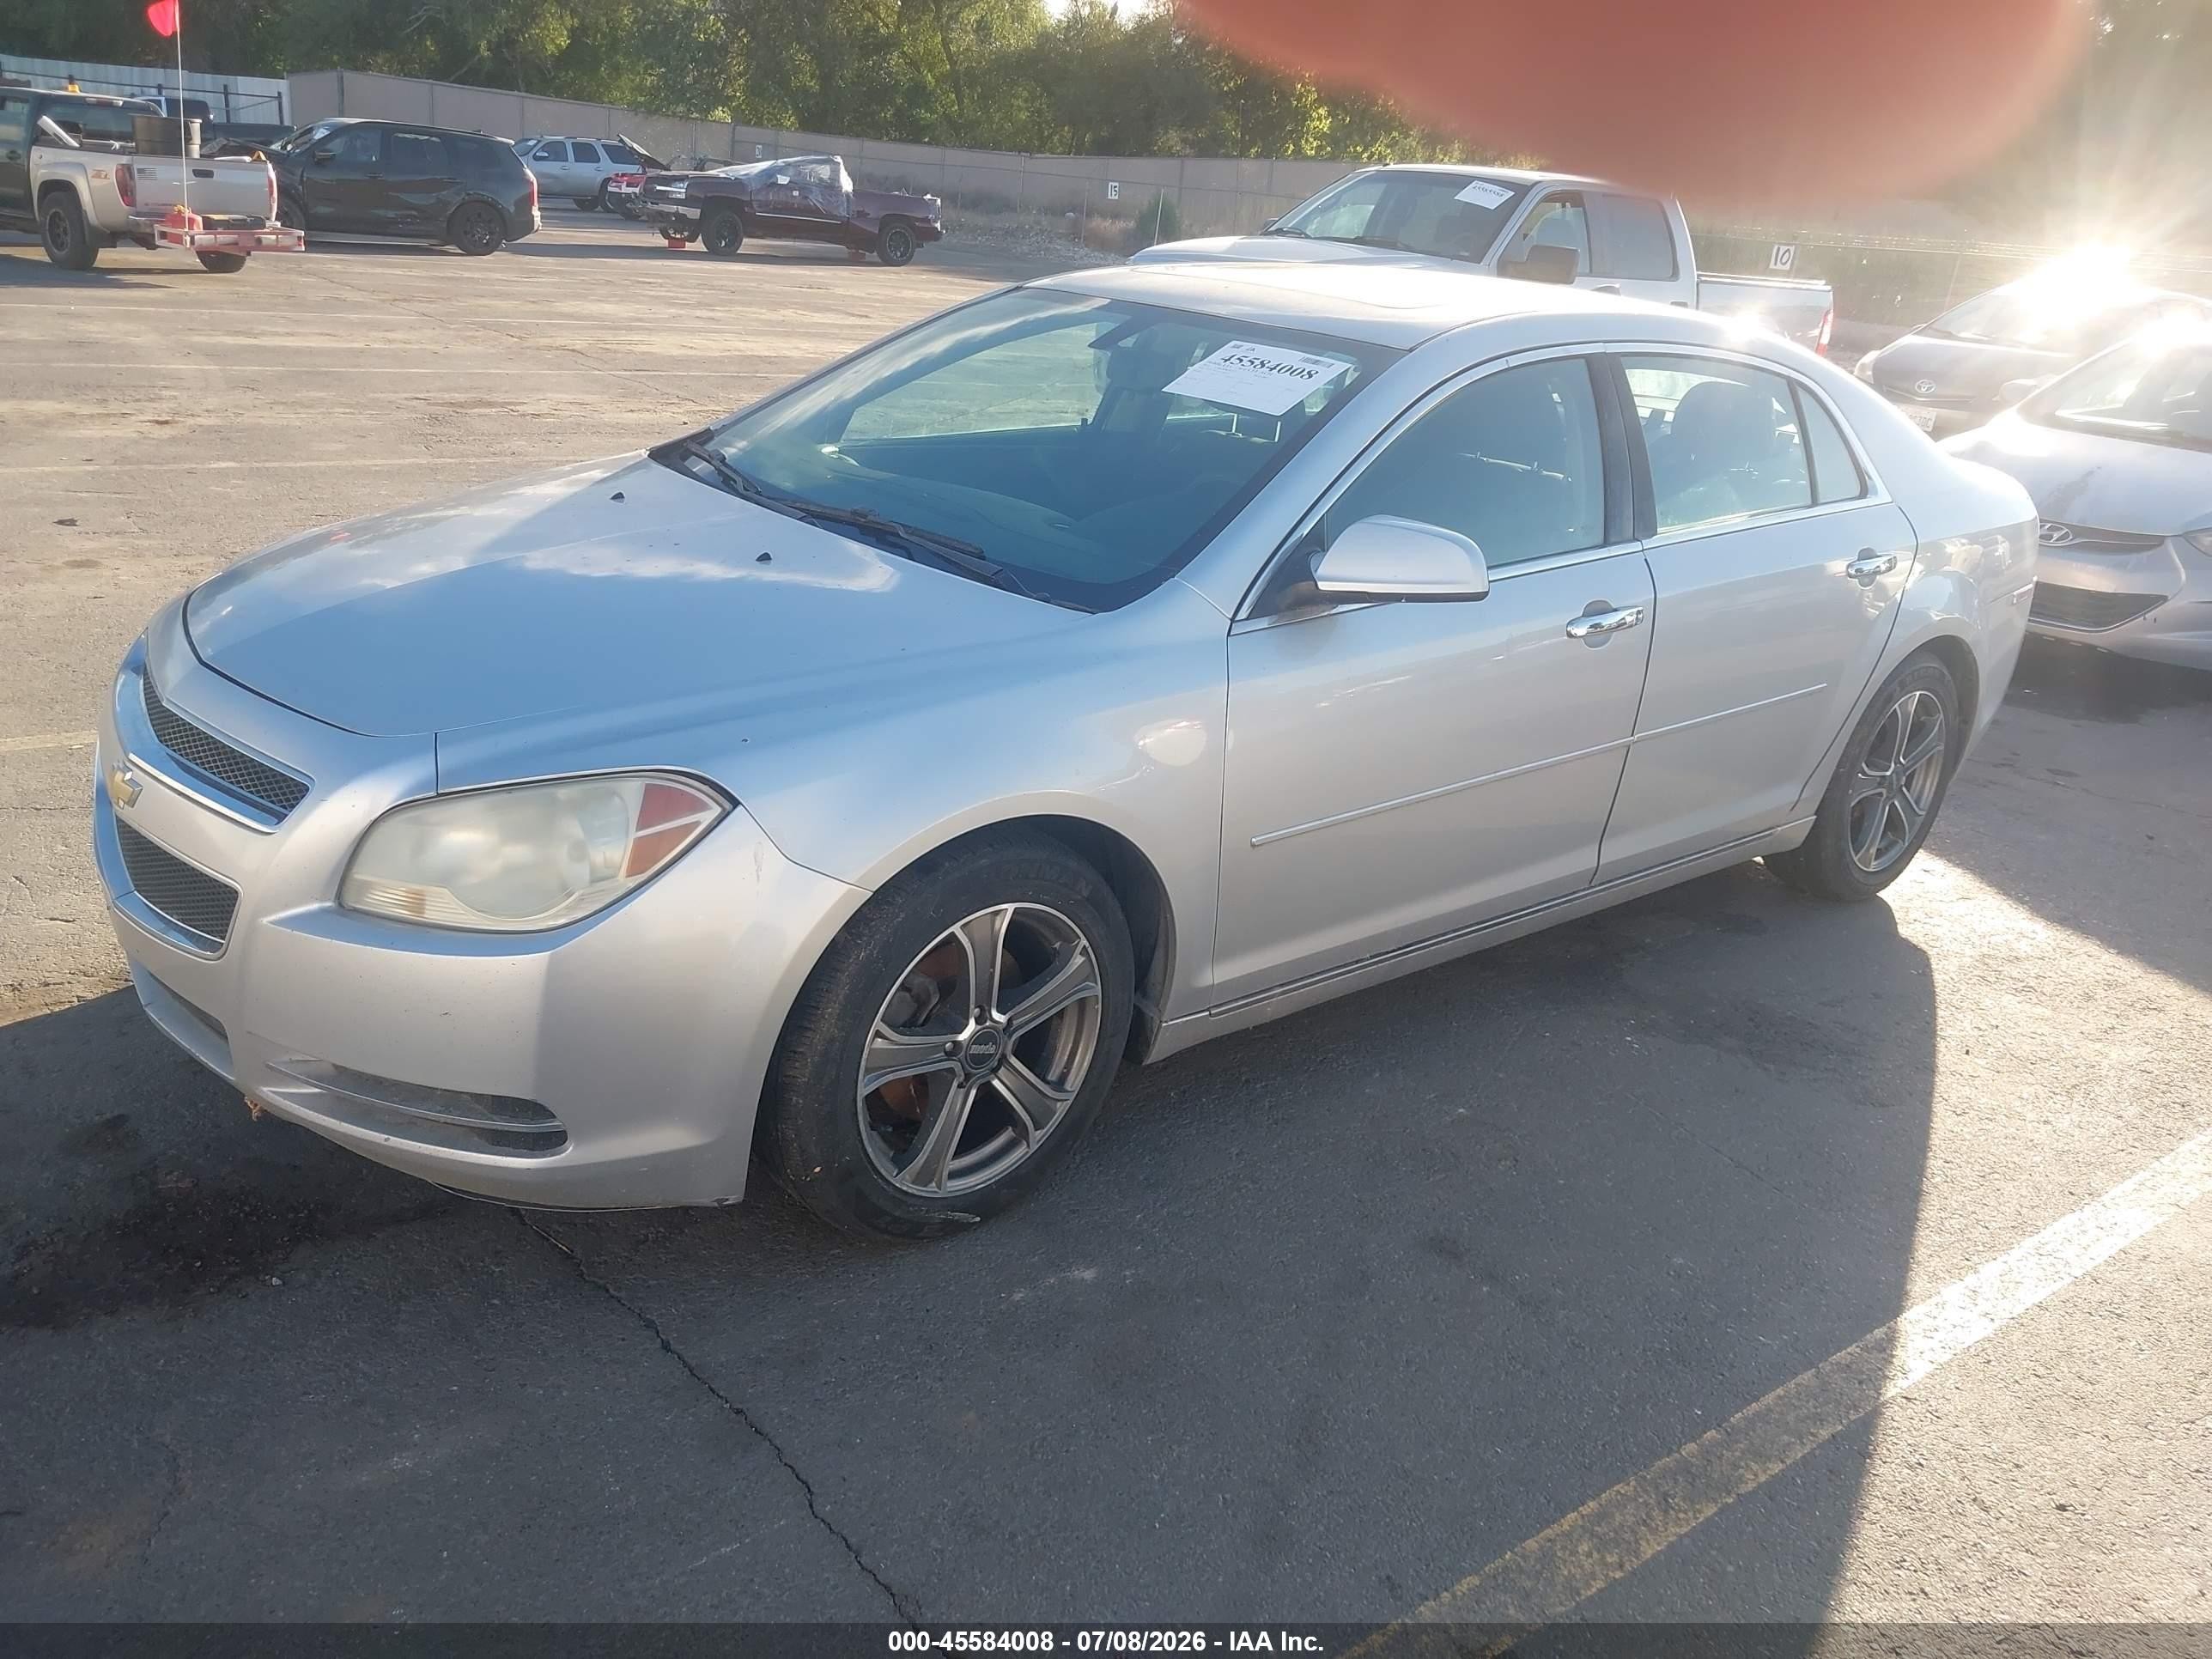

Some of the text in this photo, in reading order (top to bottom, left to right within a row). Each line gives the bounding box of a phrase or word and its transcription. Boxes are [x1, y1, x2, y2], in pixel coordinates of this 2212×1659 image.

[1110, 184, 1118, 197] 15
[1774, 246, 1791, 266] 10
[1221, 354, 1319, 380] 45584008
